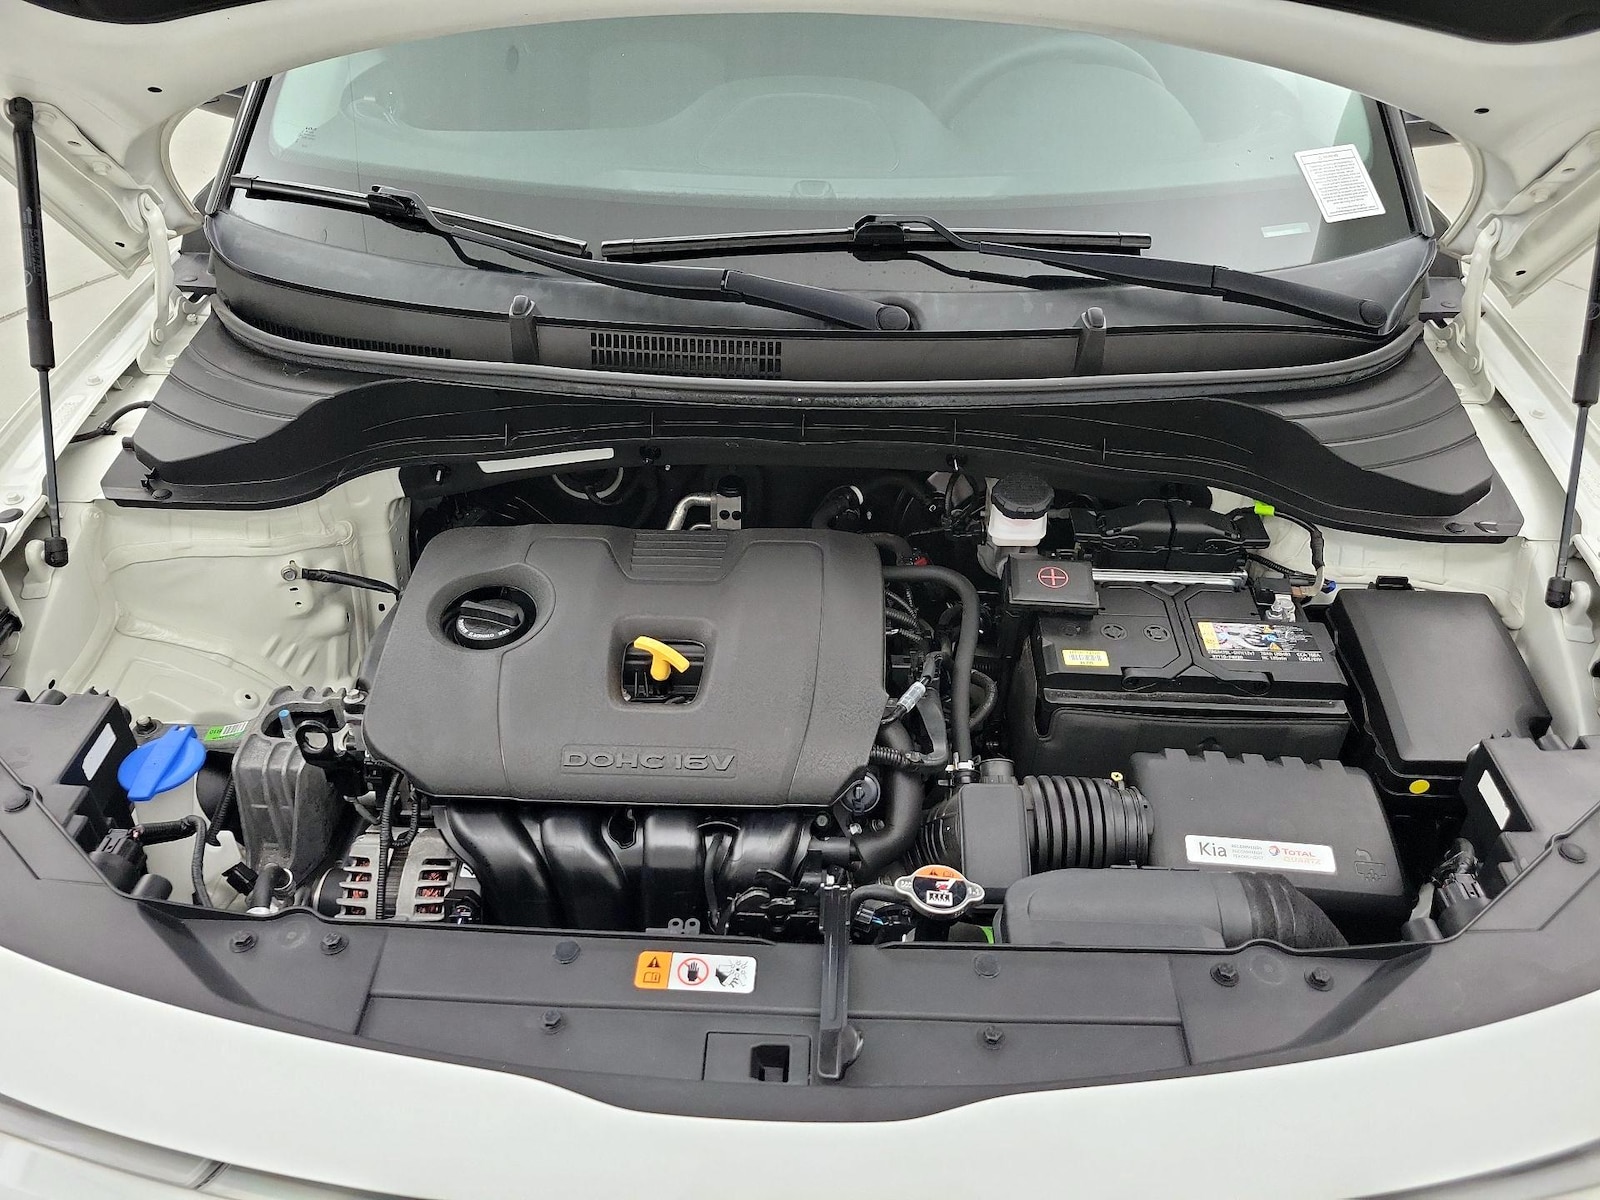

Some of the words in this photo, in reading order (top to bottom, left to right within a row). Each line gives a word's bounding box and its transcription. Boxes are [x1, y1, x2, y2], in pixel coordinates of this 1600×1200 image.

[563, 751, 666, 770] DOHC
[675, 753, 736, 772] 16V
[1199, 841, 1228, 858] Kia
